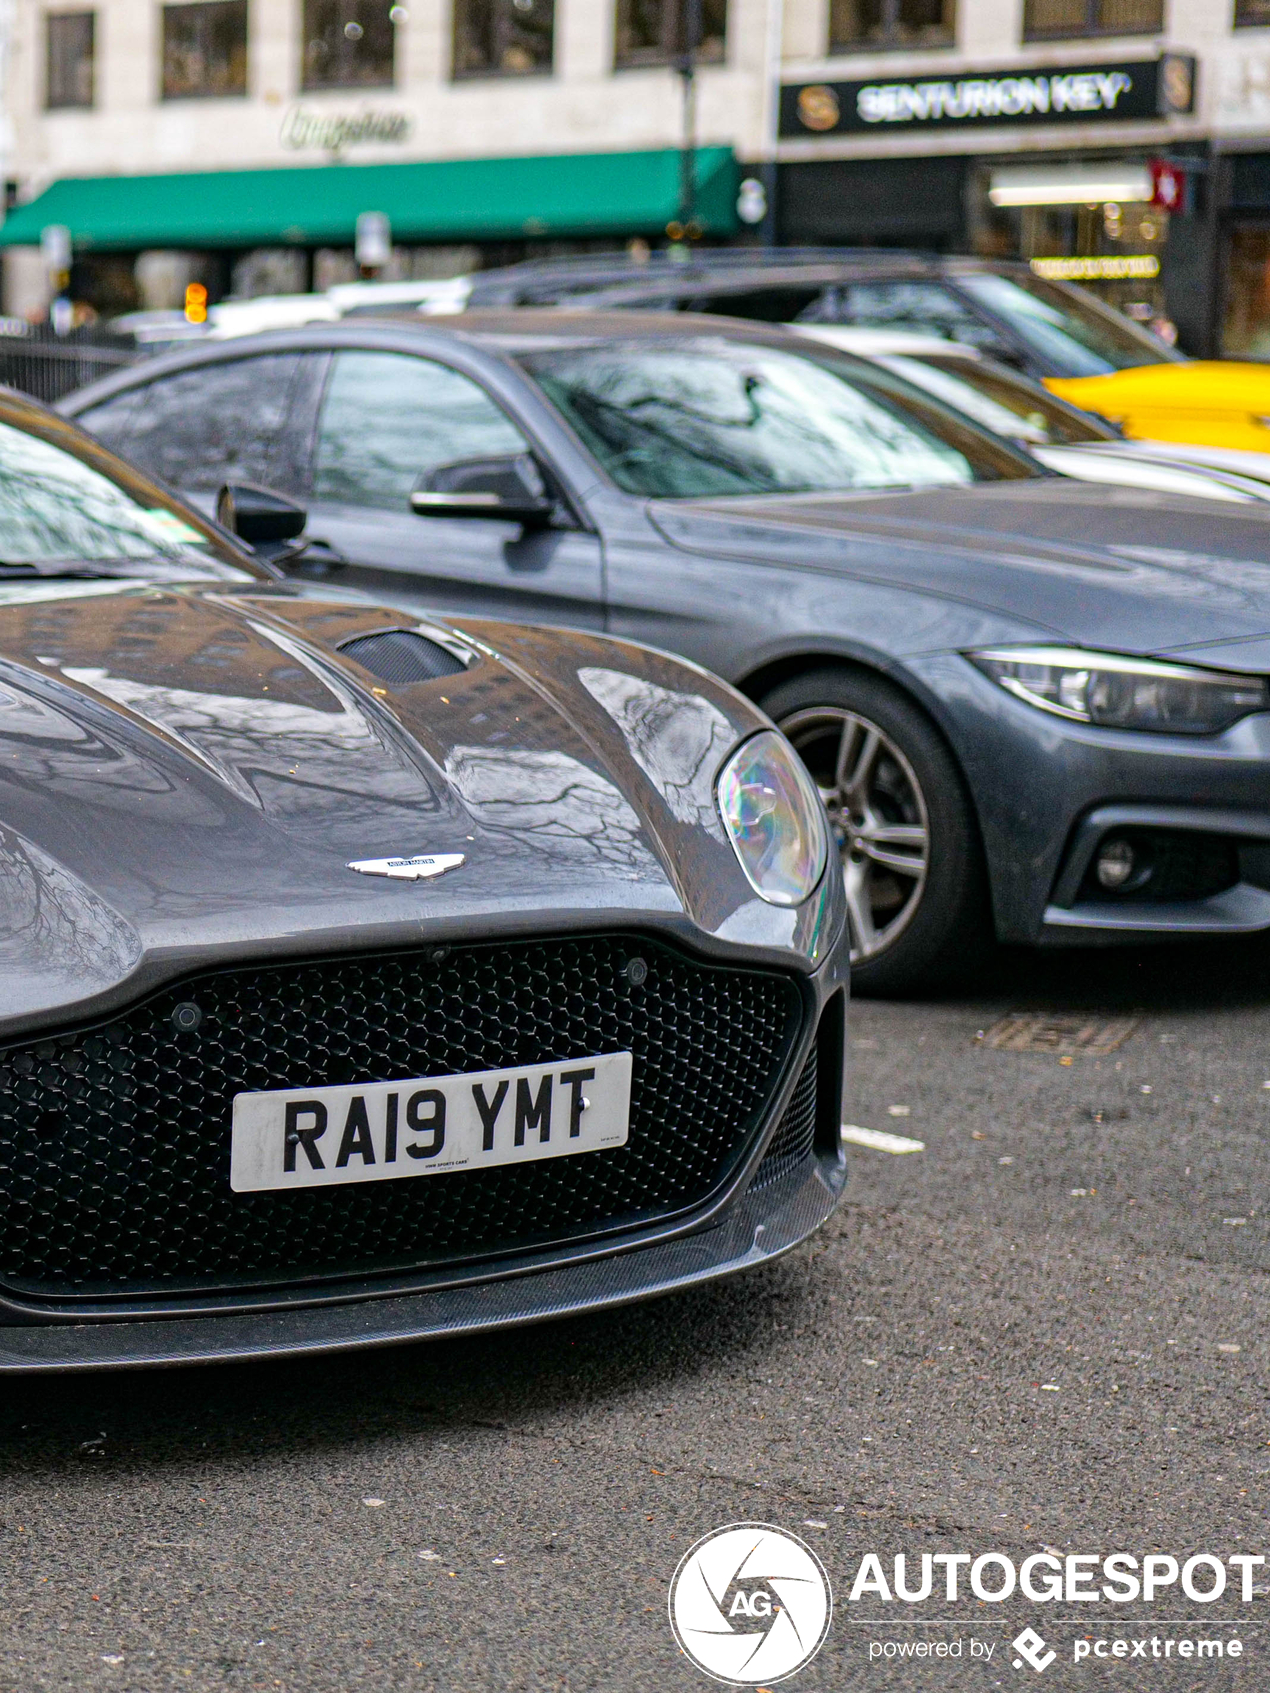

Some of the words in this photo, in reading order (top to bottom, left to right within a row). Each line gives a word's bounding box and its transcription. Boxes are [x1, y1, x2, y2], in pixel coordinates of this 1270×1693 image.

[857, 78, 1049, 122] SENTURION
[284, 1090, 446, 1172] RA19
[472, 1068, 595, 1151] YMT
